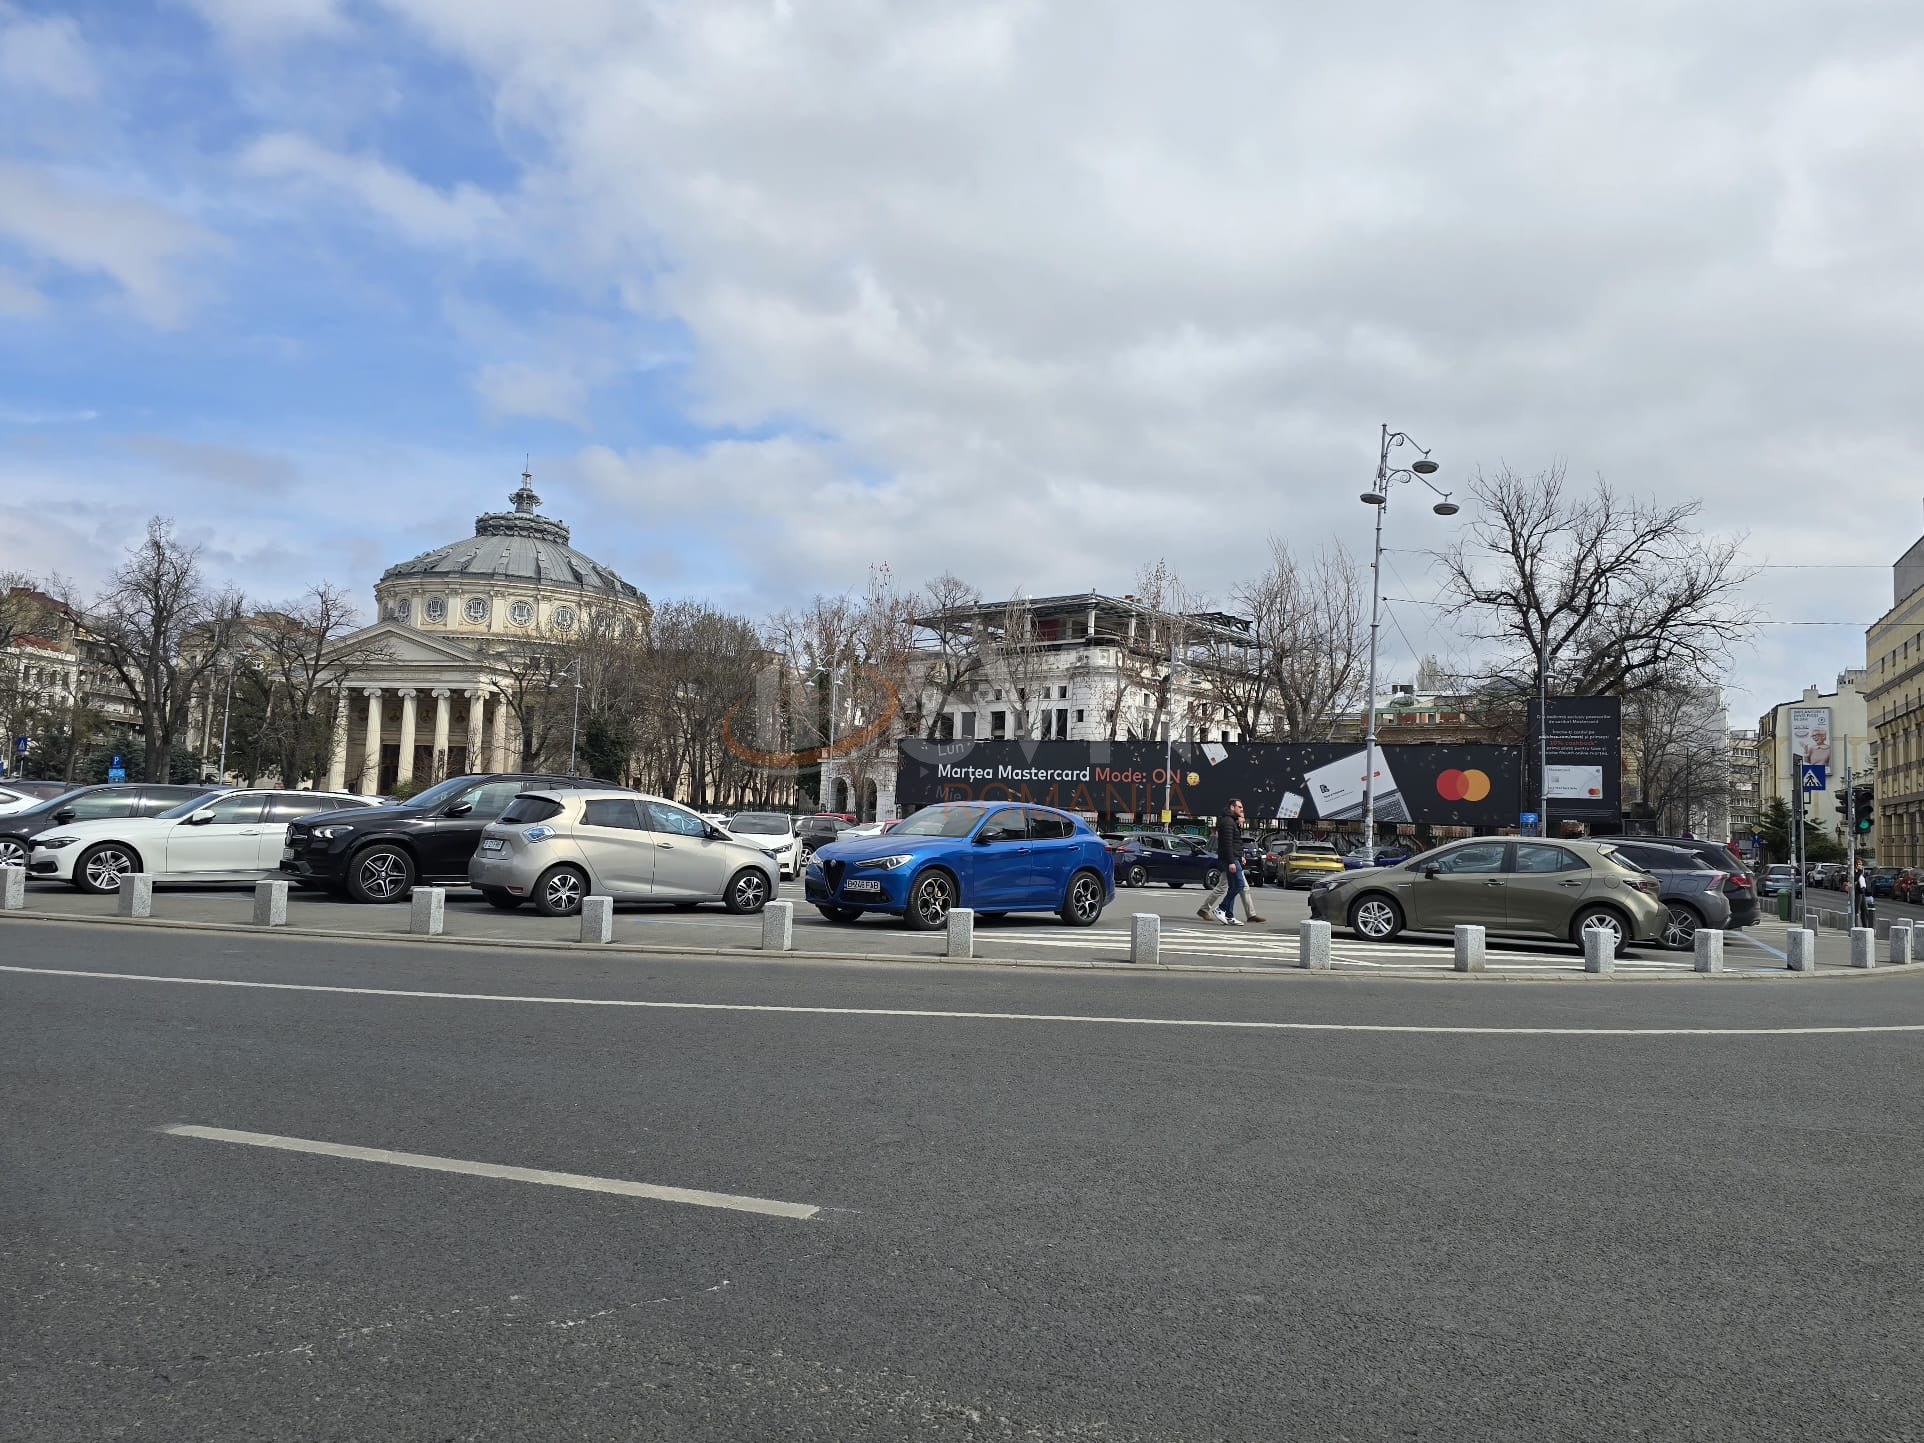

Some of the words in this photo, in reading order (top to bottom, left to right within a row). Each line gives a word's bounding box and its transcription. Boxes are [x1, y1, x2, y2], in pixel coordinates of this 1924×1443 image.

[998, 764, 1090, 782] Mastercard
[1095, 767, 1147, 783] Mode:
[1152, 768, 1181, 784] ON
